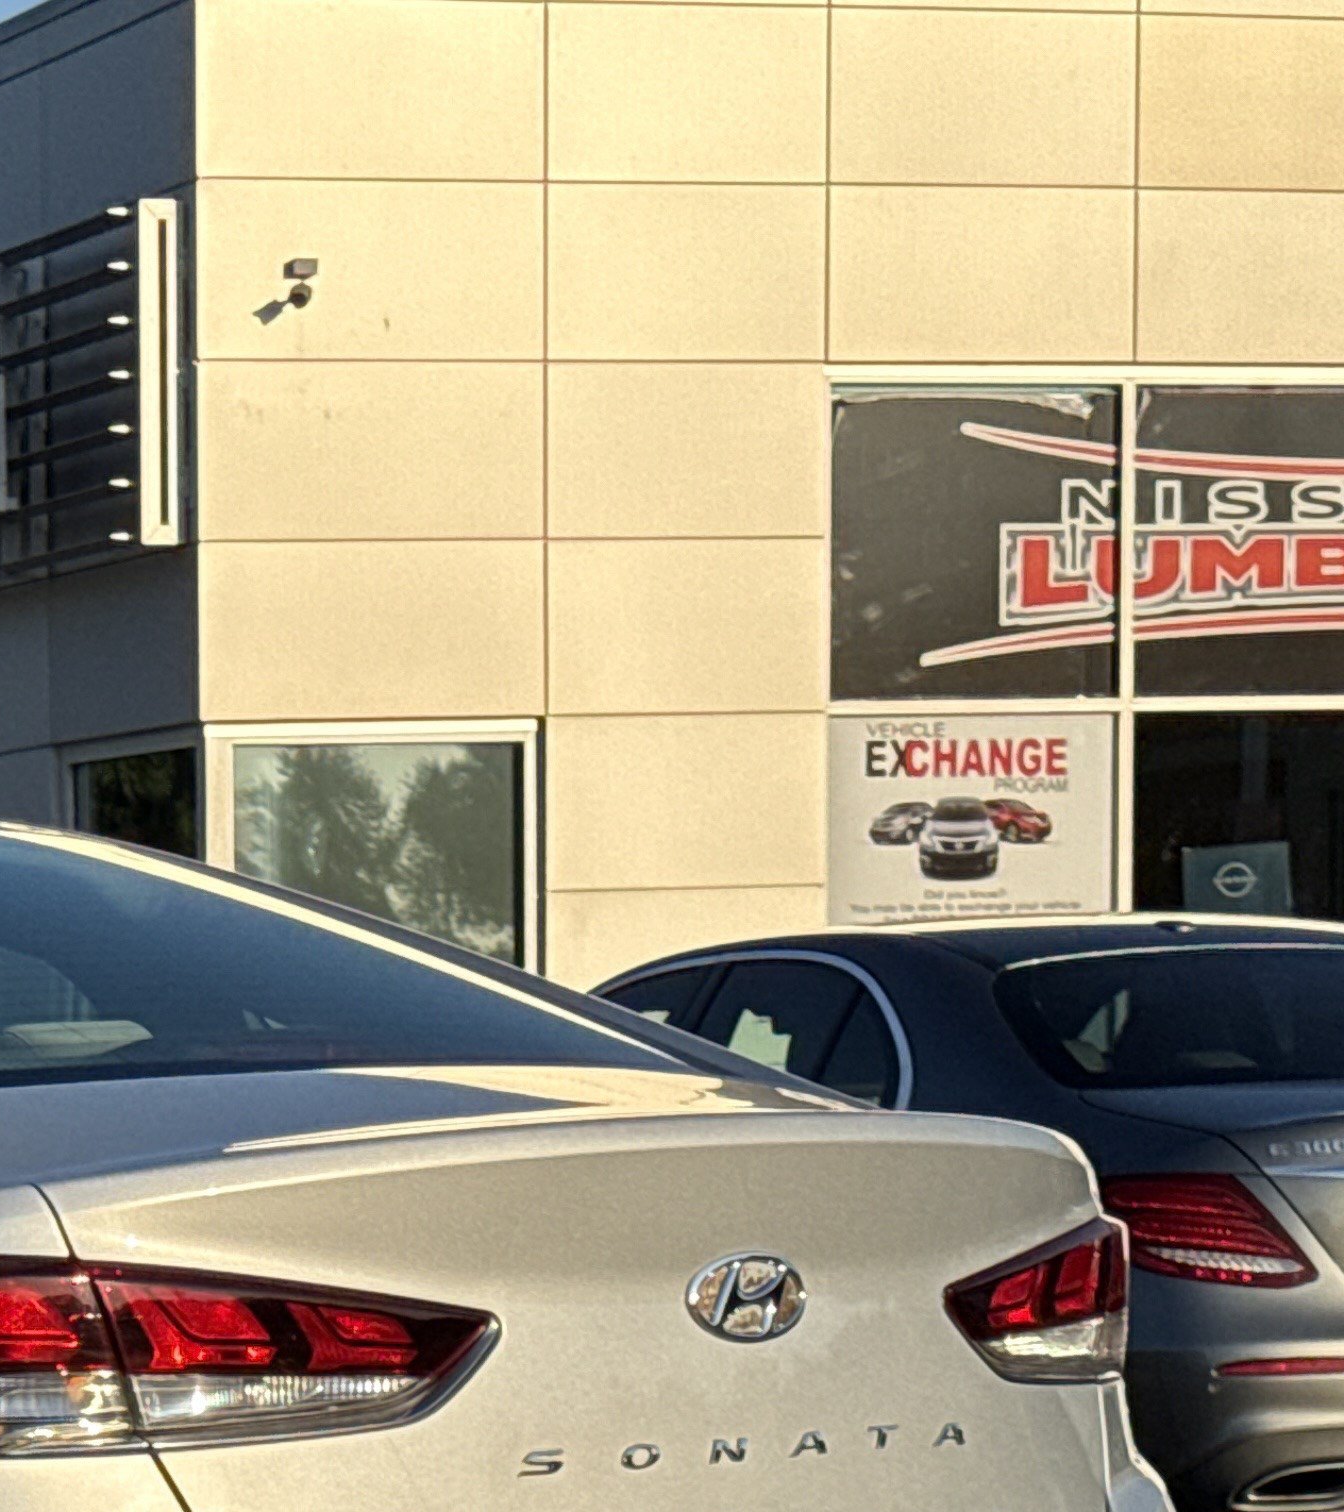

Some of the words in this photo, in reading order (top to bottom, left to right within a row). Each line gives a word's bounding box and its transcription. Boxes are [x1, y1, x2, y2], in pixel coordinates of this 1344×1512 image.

[866, 722, 946, 738] VEHICLE
[865, 738, 1068, 777] EXCHANGE
[994, 777, 1068, 793] PROGRAM
[517, 1422, 967, 1477] SONATA
